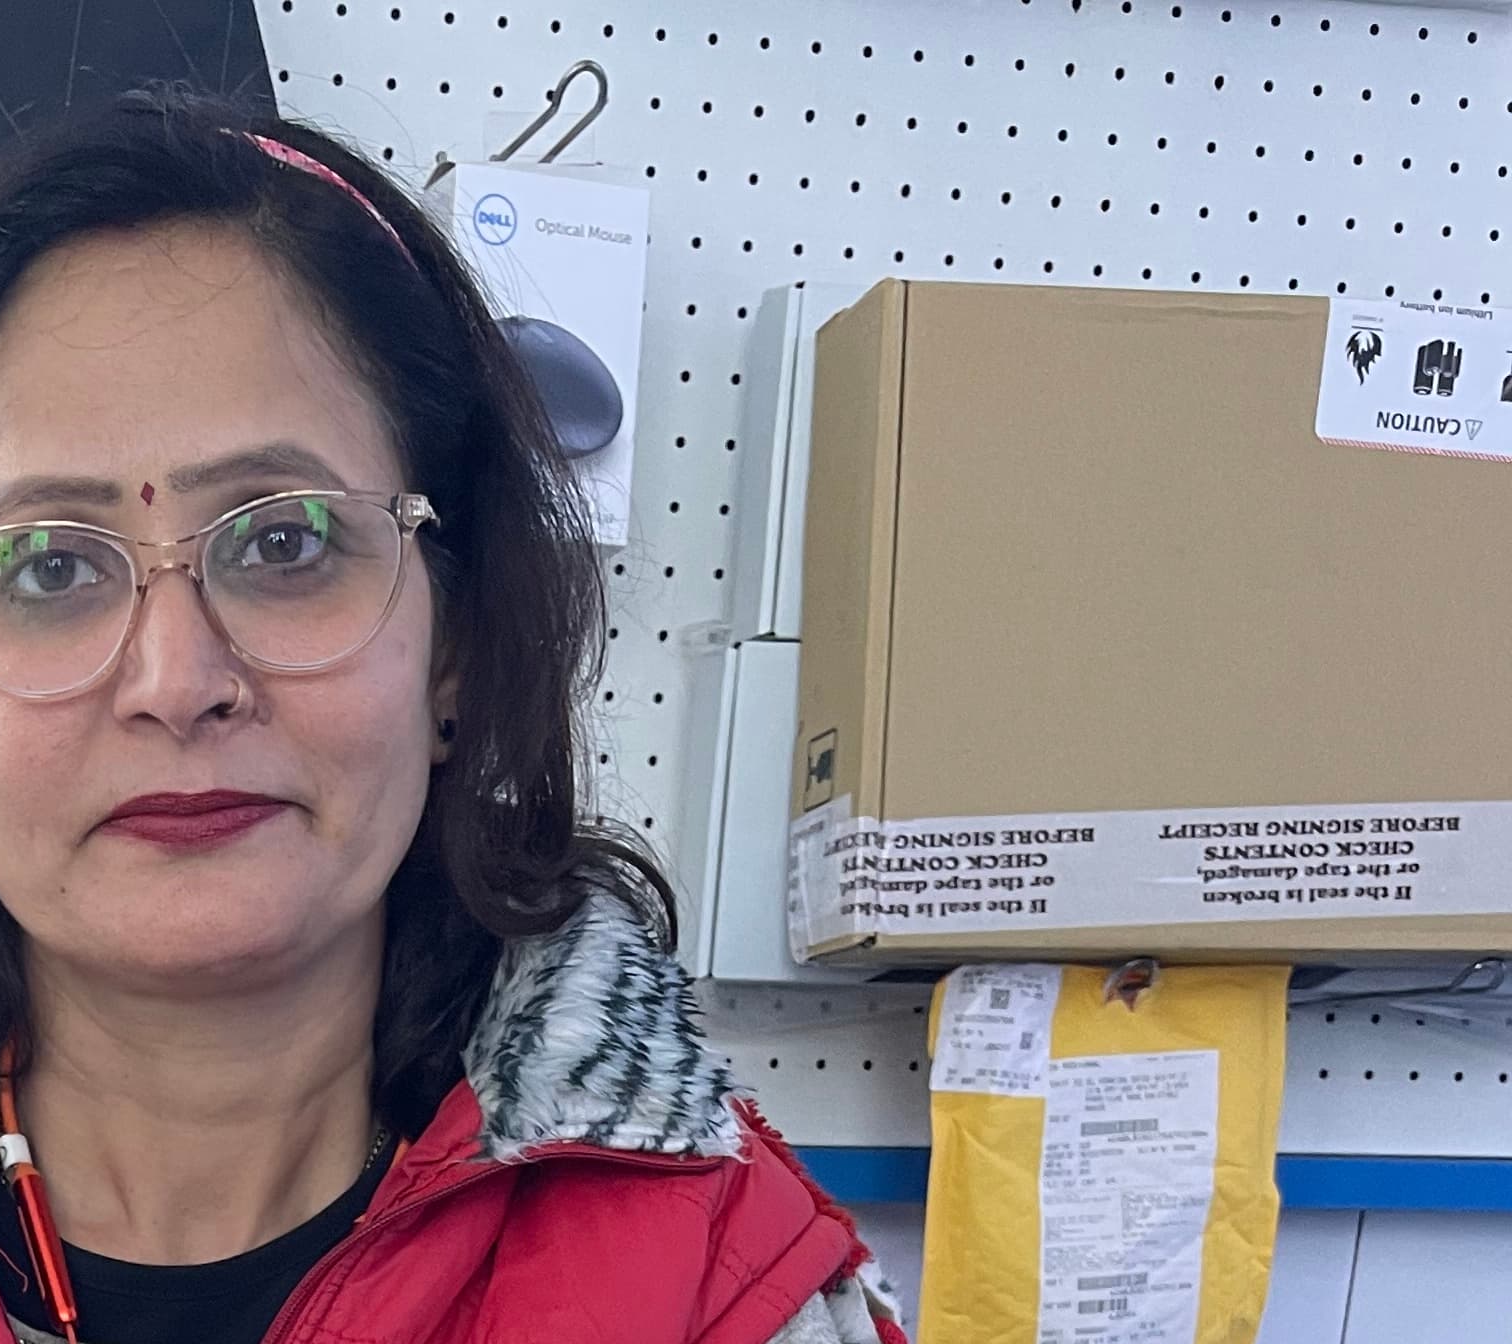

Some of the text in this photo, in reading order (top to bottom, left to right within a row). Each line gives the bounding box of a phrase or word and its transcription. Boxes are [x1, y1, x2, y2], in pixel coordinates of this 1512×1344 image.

[535, 217, 633, 245] Optical Mouse
[1376, 411, 1462, 435] CAUTION
[1158, 817, 1460, 840] BEFORE SIGNING RECEIPT
[893, 831, 995, 849] SIGNING
[1001, 828, 1095, 845] BEFORE
[1203, 841, 1414, 861] CHECK CONTENTS
[968, 853, 1048, 868] CHECK
[1397, 862, 1420, 873] or
[1304, 864, 1351, 878] tape
[1357, 862, 1390, 875] the
[934, 876, 984, 892] tape
[988, 876, 1023, 888] the
[1029, 875, 1055, 888] or
[1203, 885, 1412, 904] If the seal is broken
[917, 903, 934, 917] is
[941, 902, 981, 917] seal
[987, 900, 1023, 913] the
[1028, 899, 1048, 913] If
